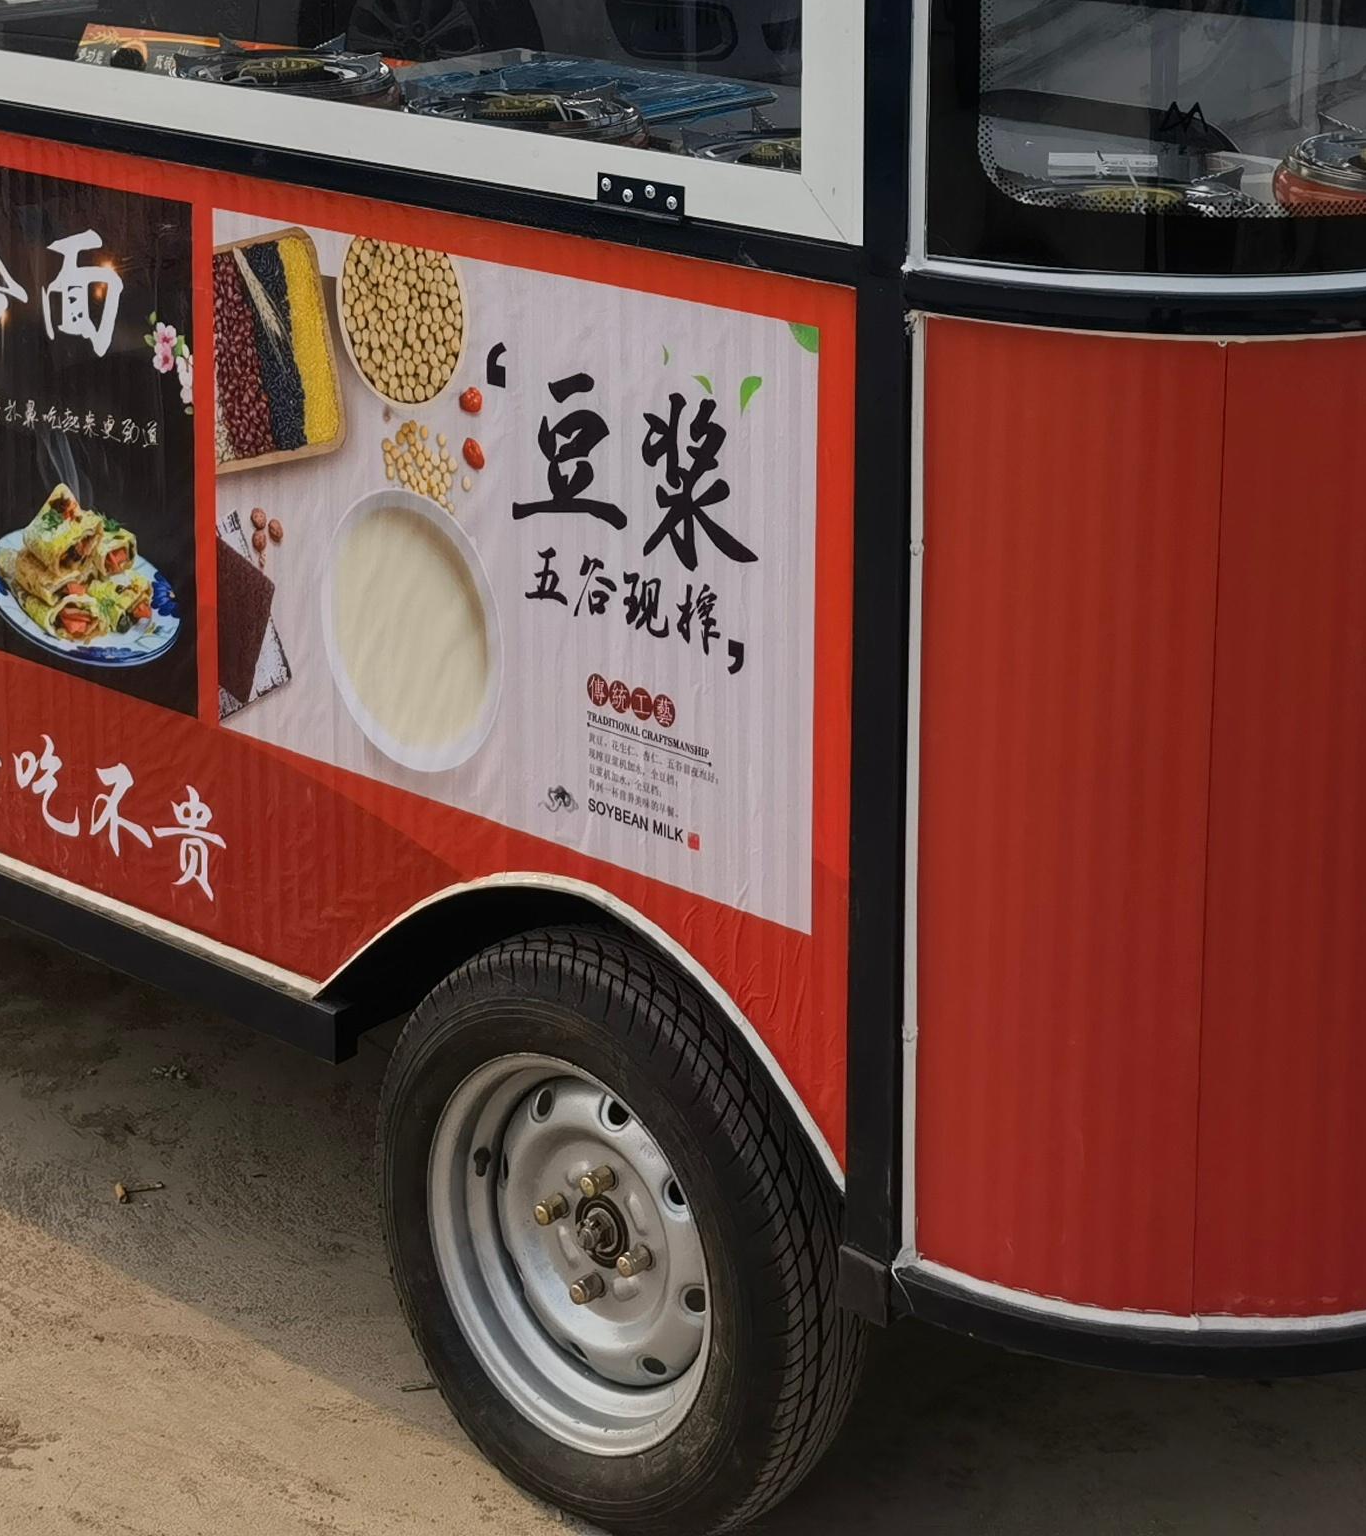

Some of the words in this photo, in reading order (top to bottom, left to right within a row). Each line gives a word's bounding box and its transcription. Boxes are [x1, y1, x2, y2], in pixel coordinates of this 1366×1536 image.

[511, 371, 759, 571] 豆浆
[524, 549, 722, 657] 五谷现榨
[587, 711, 641, 738] TRADITIONAL
[641, 728, 710, 759] CRAFTSMANSHIP
[588, 798, 649, 831] SOYBEAN
[652, 819, 684, 843] MILK
